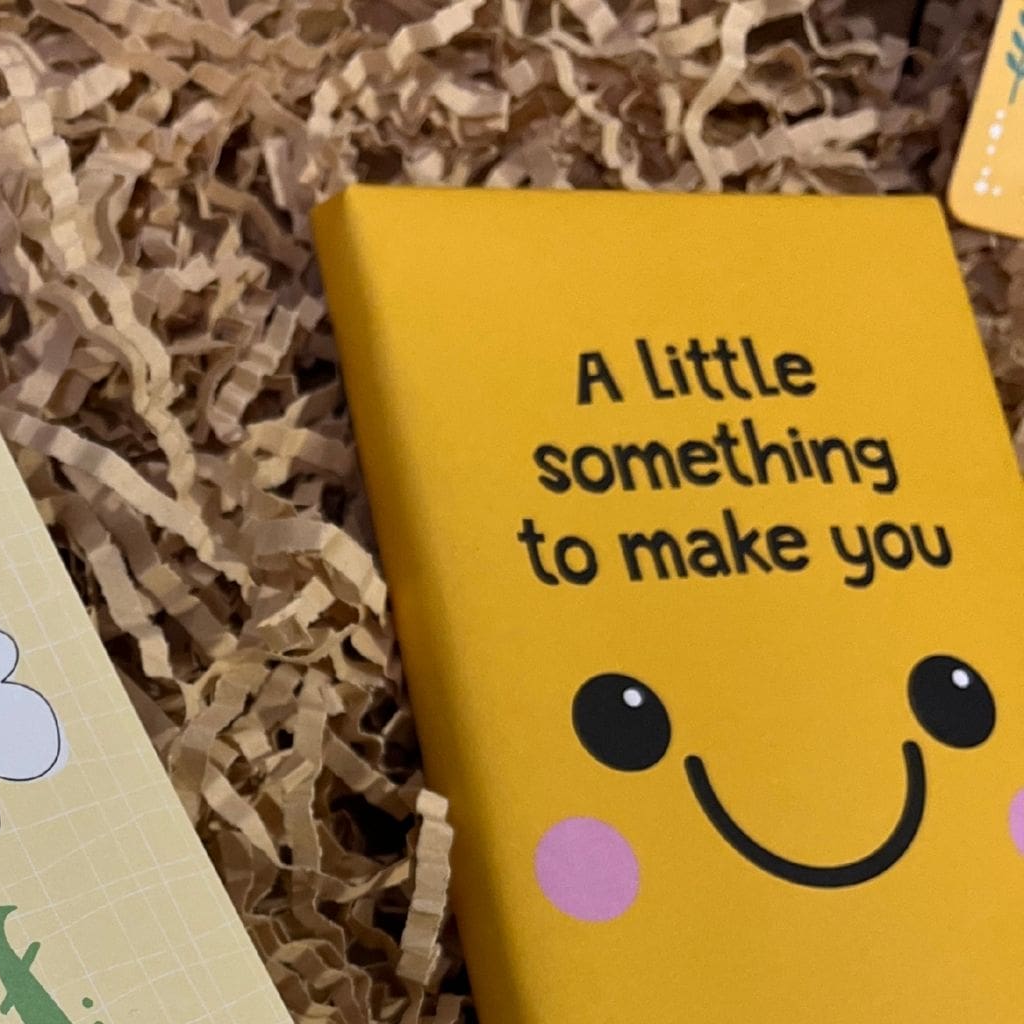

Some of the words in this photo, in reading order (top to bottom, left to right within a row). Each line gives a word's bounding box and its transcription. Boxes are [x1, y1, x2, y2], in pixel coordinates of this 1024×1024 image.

[576, 351, 624, 405] A
[636, 337, 816, 401] little
[533, 418, 899, 495] something
[517, 518, 599, 587] to
[618, 508, 810, 583] make
[830, 521, 954, 589] you
